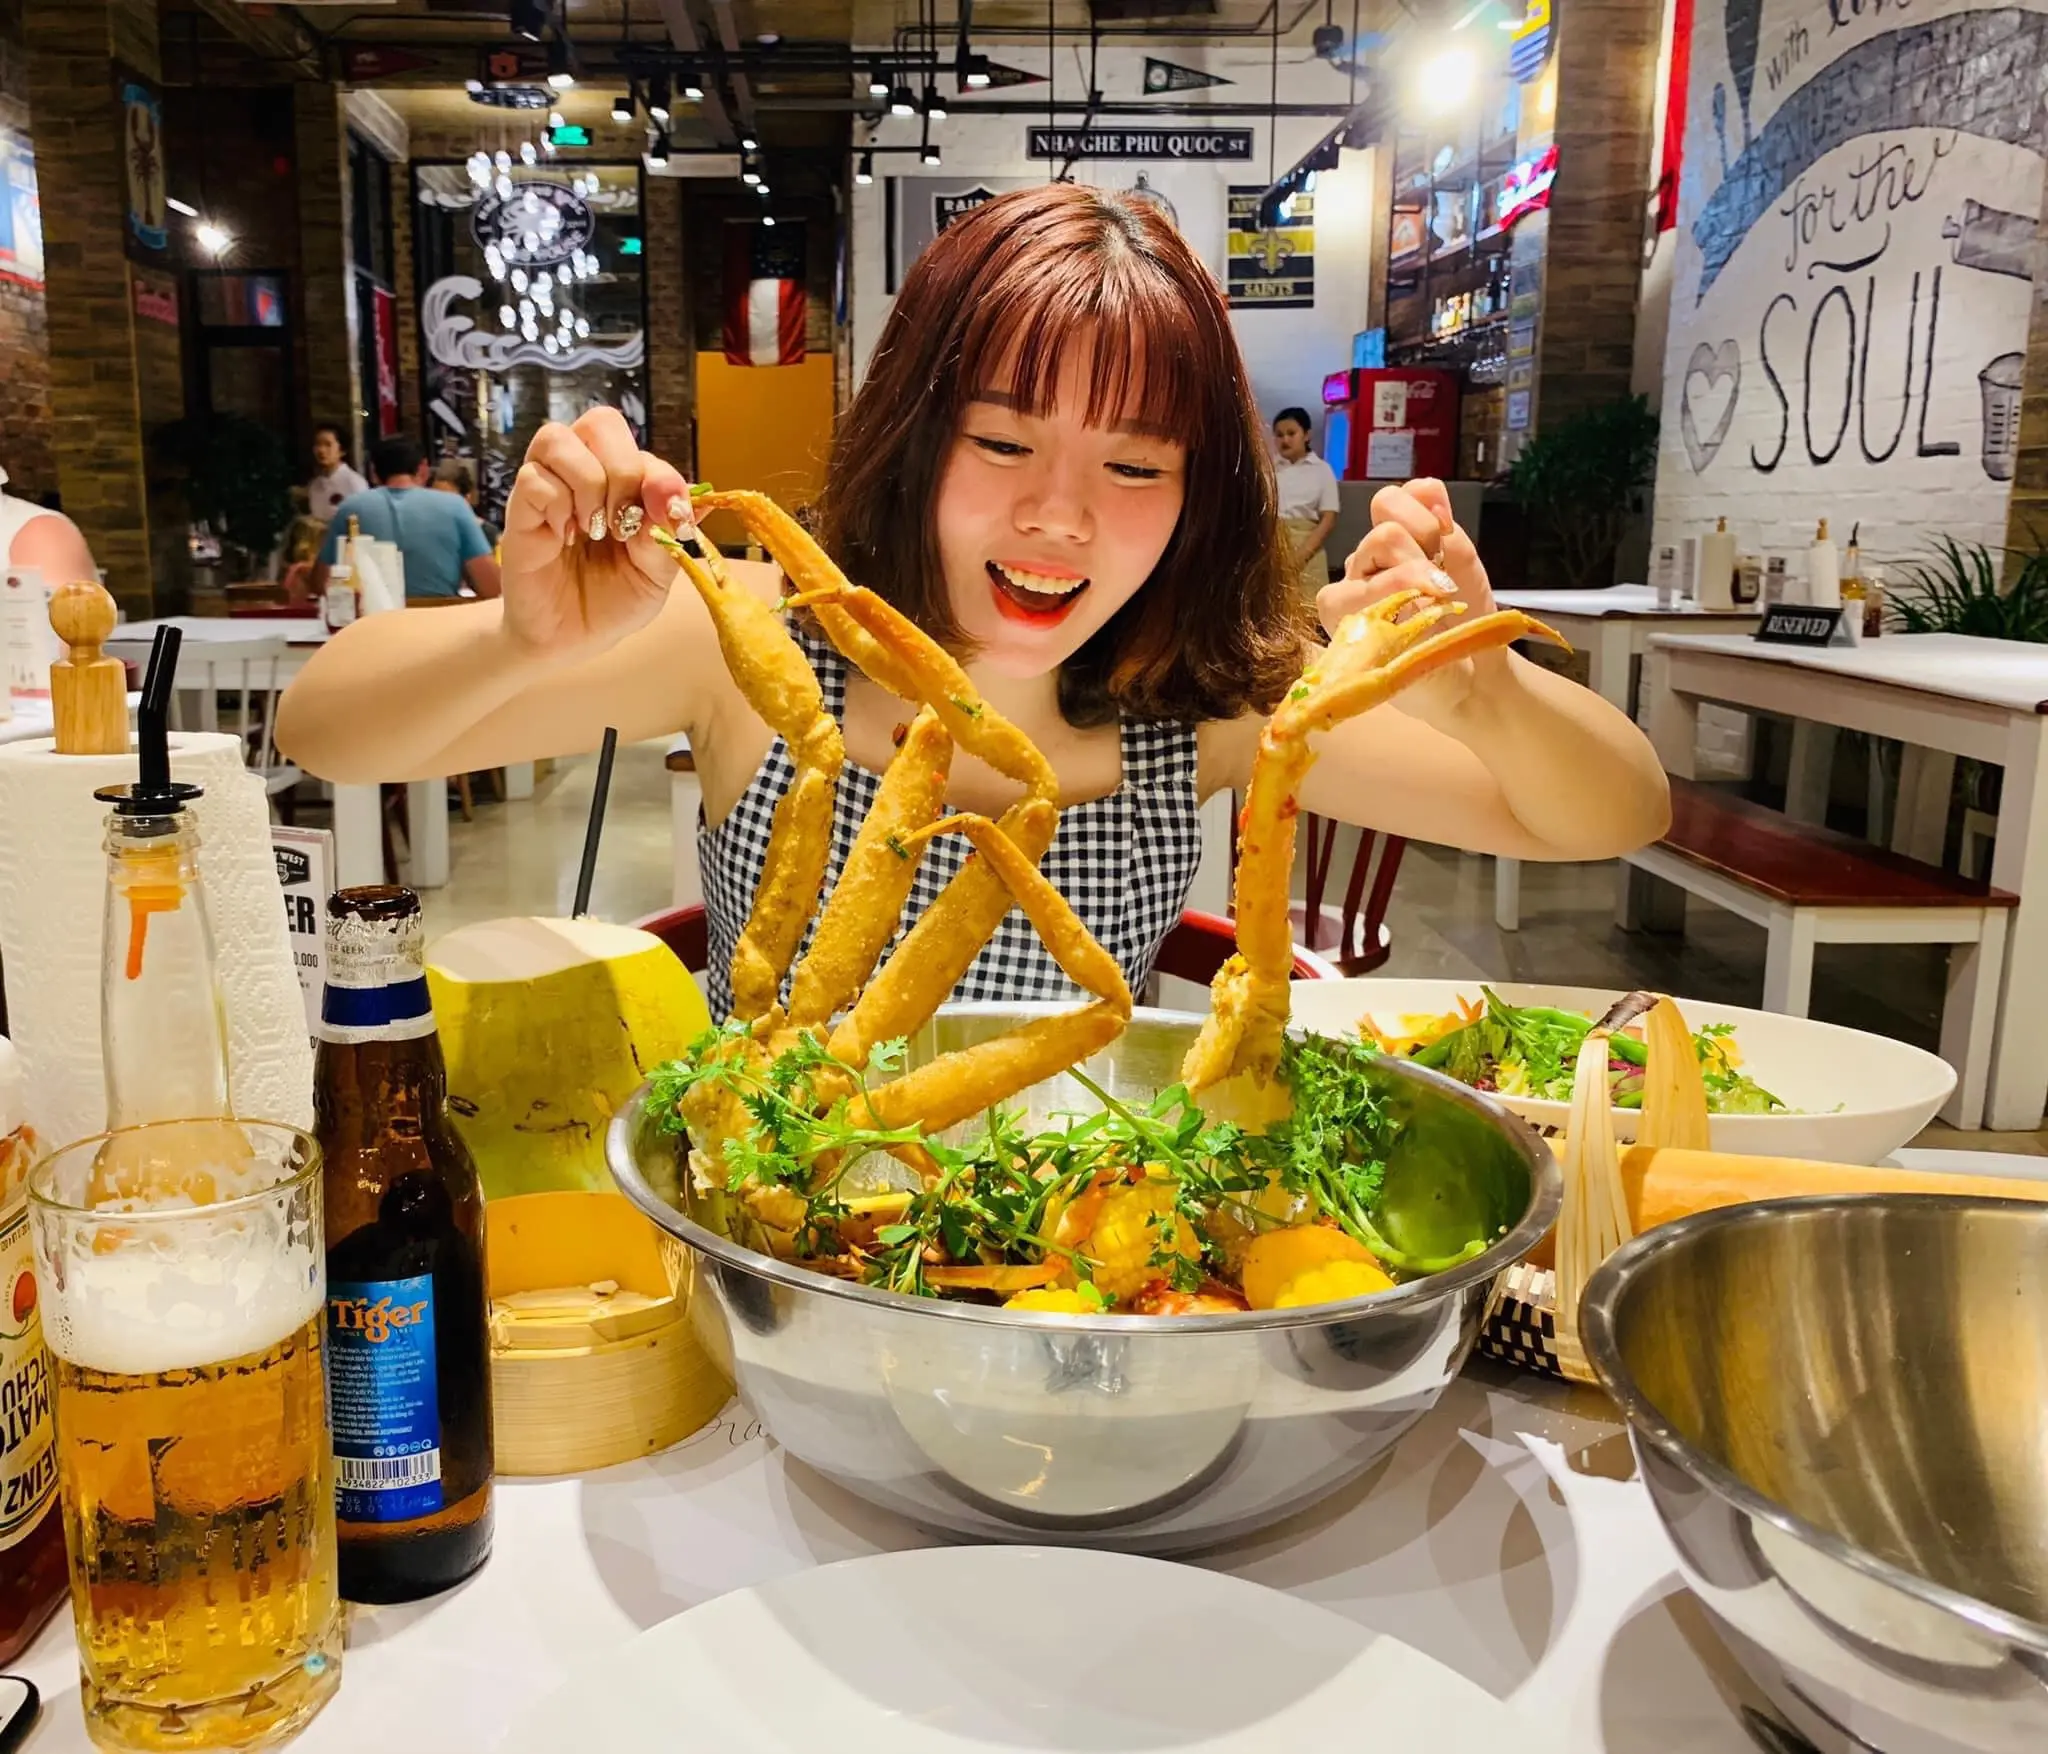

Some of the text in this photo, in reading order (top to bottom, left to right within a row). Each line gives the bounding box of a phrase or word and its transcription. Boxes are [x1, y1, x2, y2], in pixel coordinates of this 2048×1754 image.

[1766, 19, 1809, 90] with
[1080, 135, 1121, 152] GHE
[1125, 135, 1164, 152] PHU
[1167, 135, 1224, 154] QUOC
[1780, 131, 1958, 272] for the
[1243, 282, 1294, 297] SAINTS
[1751, 265, 1961, 474] SOUL
[1766, 615, 1832, 637] RESERVED
[284, 893, 317, 935] ER
[331, 1296, 429, 1344] Tiger
[2, 1348, 48, 1415] TCHU
